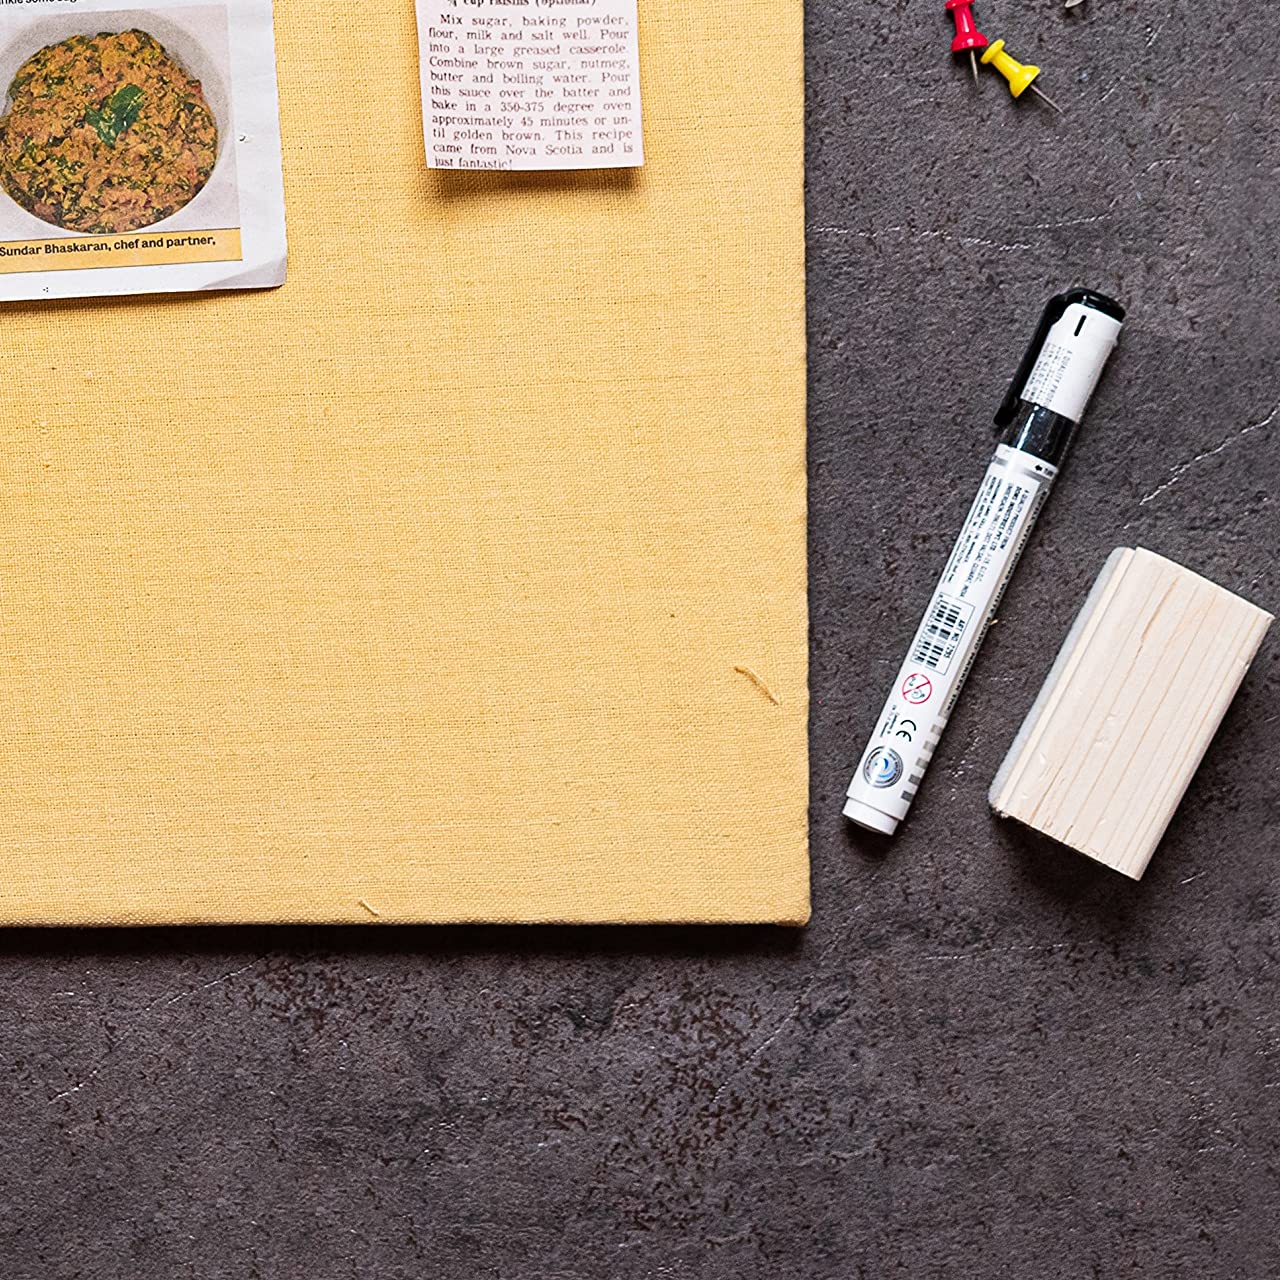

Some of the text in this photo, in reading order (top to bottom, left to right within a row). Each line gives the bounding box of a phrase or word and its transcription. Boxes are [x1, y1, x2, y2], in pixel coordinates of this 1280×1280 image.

[440, 14, 462, 25] Mix
[466, 29, 492, 40] milk
[429, 56, 523, 70] Combine brown
[430, 70, 493, 83] butter and
[431, 85, 491, 98] this sauce
[431, 99, 458, 110] bake
[431, 114, 513, 128] approximately
[453, 128, 632, 141] golden recipe
[470, 143, 497, 155] from
[44, 242, 111, 254] Bhaskaran,
[113, 238, 139, 250] chef
[141, 237, 163, 248] and
[166, 236, 215, 248] partner,
